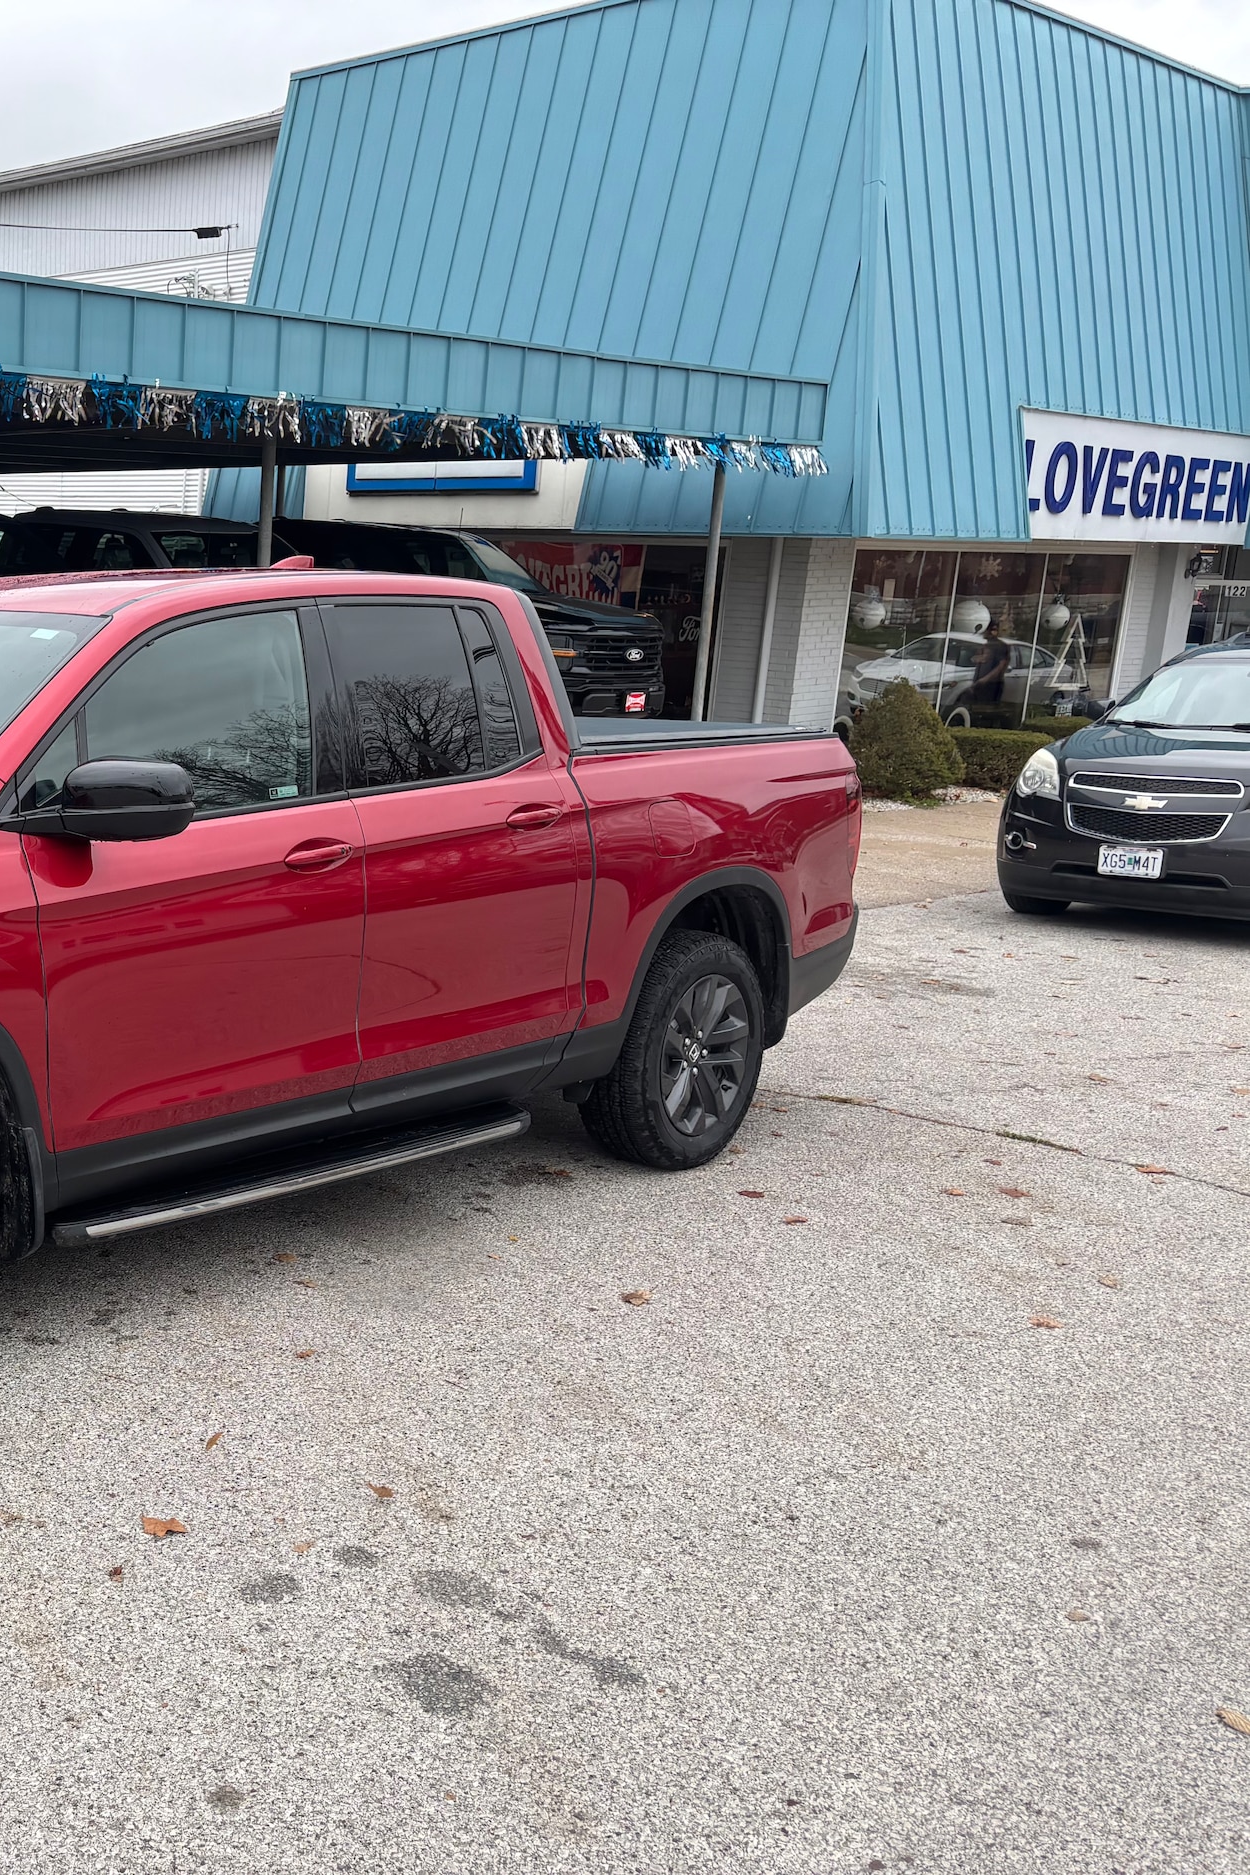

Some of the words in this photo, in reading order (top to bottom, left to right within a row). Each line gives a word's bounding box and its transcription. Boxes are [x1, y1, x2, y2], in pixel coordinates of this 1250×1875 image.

[1025, 439, 1250, 523] LOVEGREEN
[1227, 586, 1246, 597] 122
[678, 615, 701, 642] For
[1101, 852, 1127, 869] XG5
[1132, 855, 1159, 872] M4T
